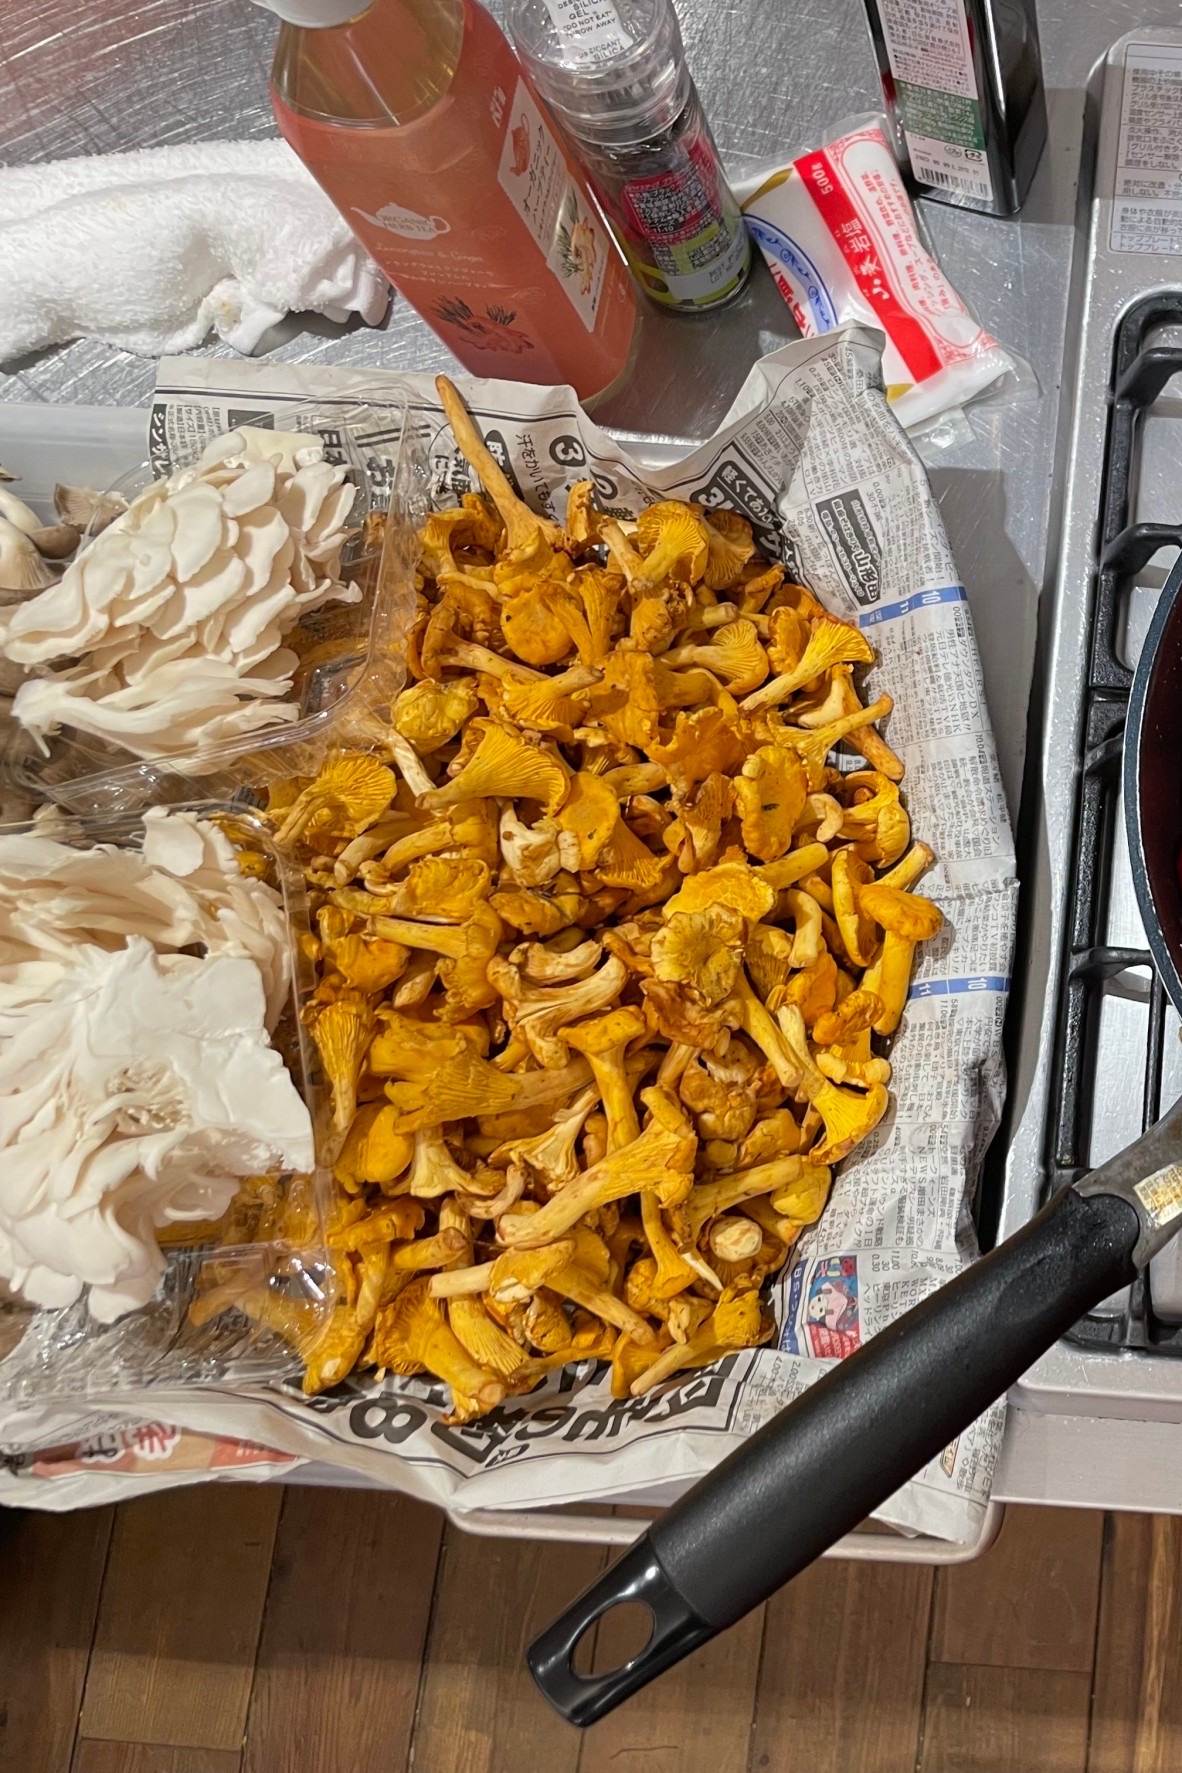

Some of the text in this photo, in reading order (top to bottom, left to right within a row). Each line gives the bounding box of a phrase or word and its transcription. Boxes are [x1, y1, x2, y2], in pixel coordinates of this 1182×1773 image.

[568, 8, 589, 20] GEL
[578, 16, 594, 26] NOT
[595, 17, 616, 28] AWAY
[810, 161, 835, 197] 500g
[555, 442, 580, 466] 3
[850, 547, 887, 602] 山形田
[918, 589, 936, 606] 10
[957, 637, 979, 719] ダウンタウンDX
[979, 764, 999, 845] 報道ステーション
[967, 977, 986, 989] 10
[927, 1146, 936, 1217] トークィーンズ
[871, 1253, 880, 1272] 0.30
